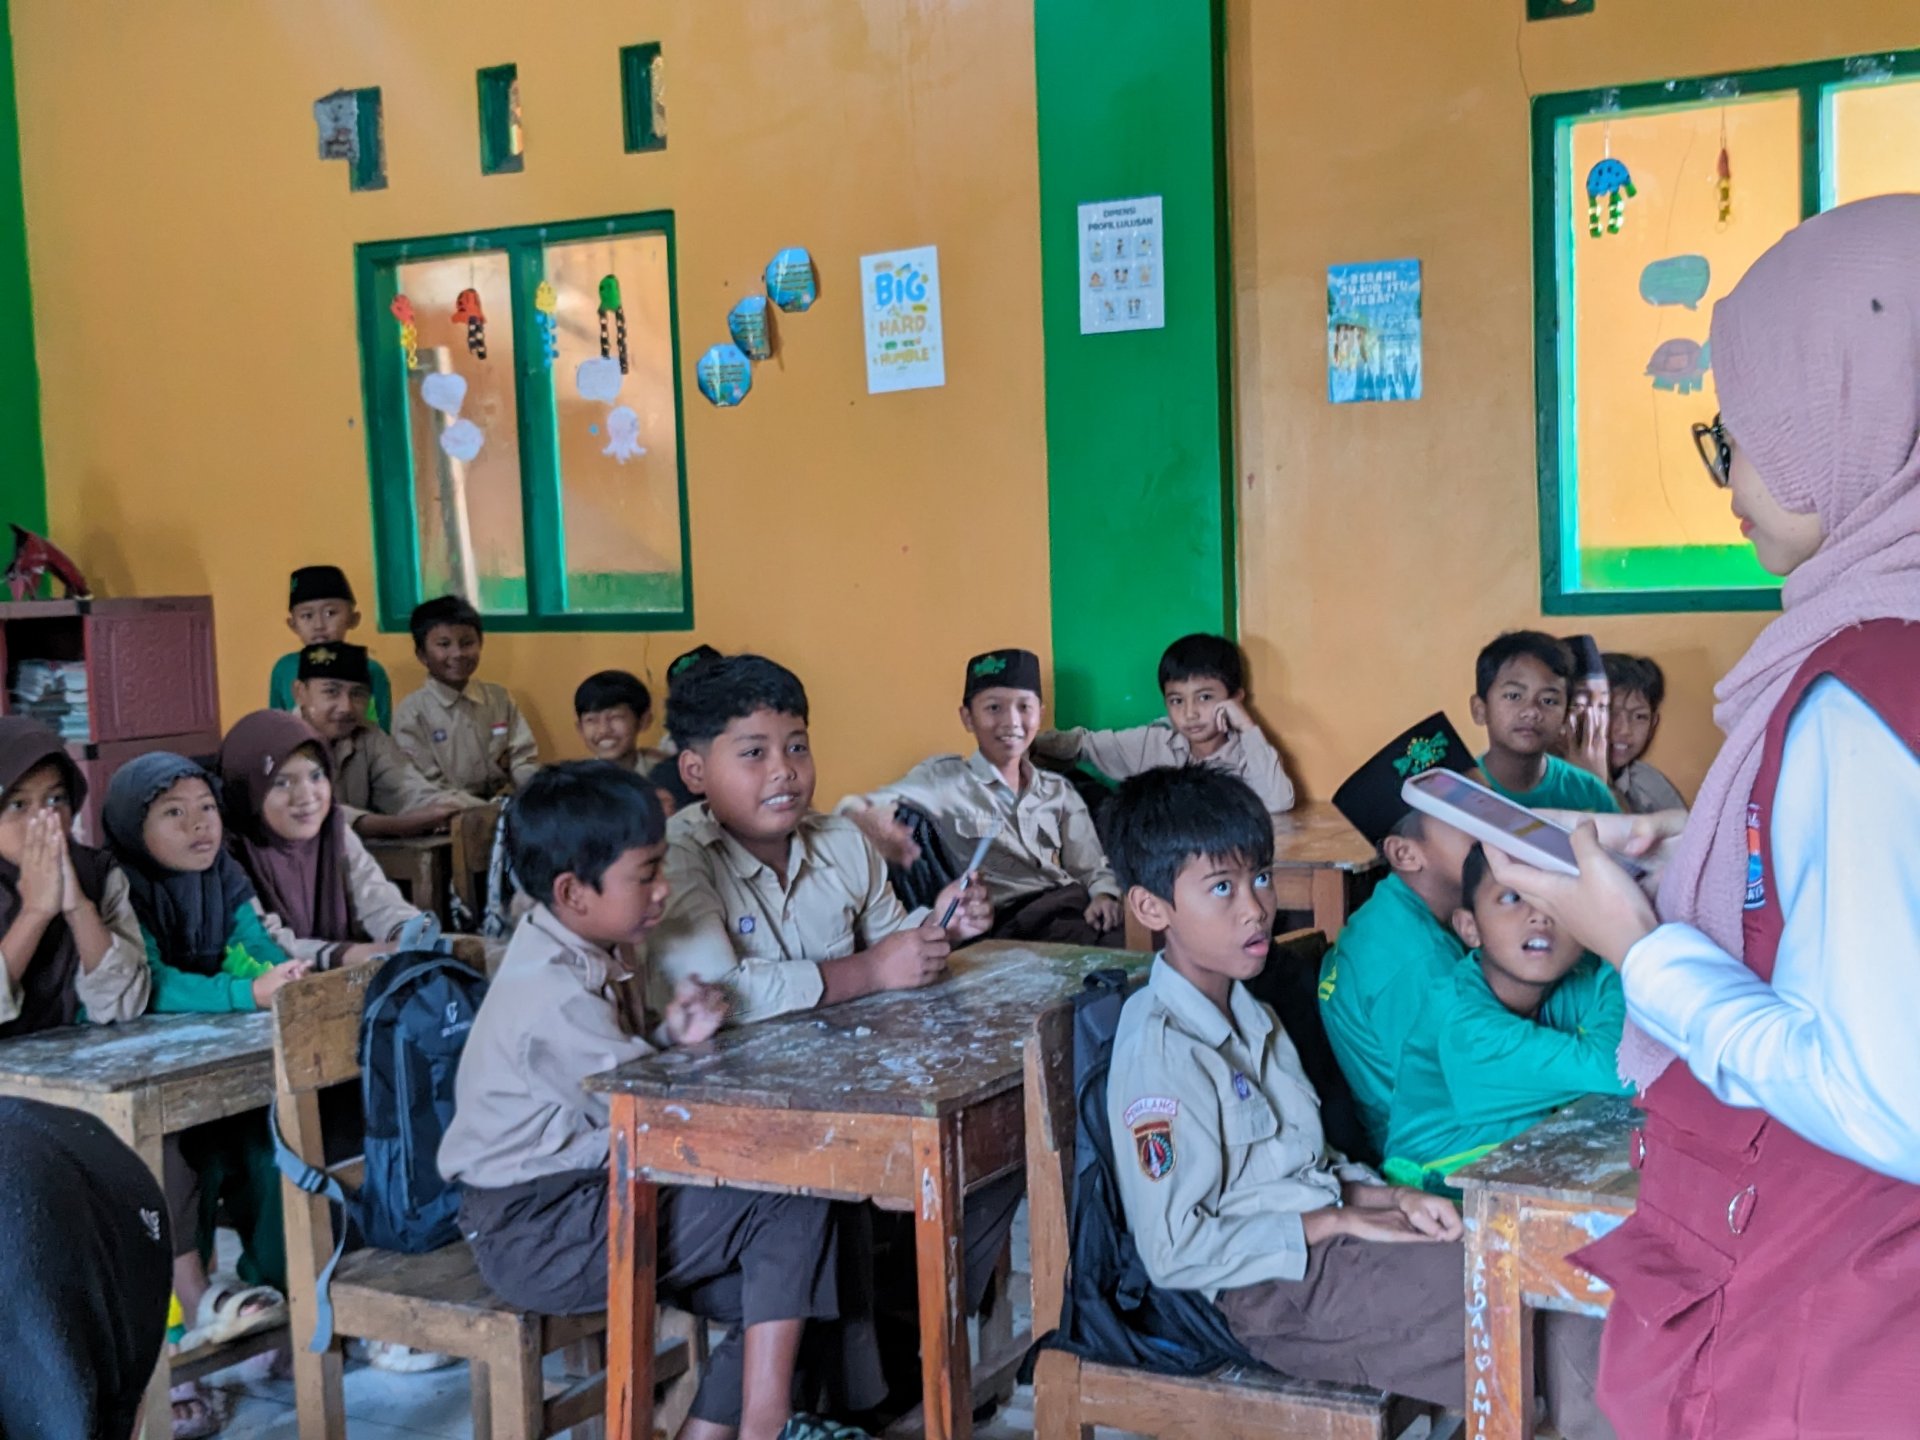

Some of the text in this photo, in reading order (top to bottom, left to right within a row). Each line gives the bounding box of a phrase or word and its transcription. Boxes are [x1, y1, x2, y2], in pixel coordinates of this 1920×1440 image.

[1103, 207, 1136, 218] DIMENSI
[1088, 218, 1153, 232] PROFIL LULUSAN
[875, 270, 926, 306] BIG
[879, 315, 926, 337] HARD
[880, 347, 929, 366] HUMBLE
